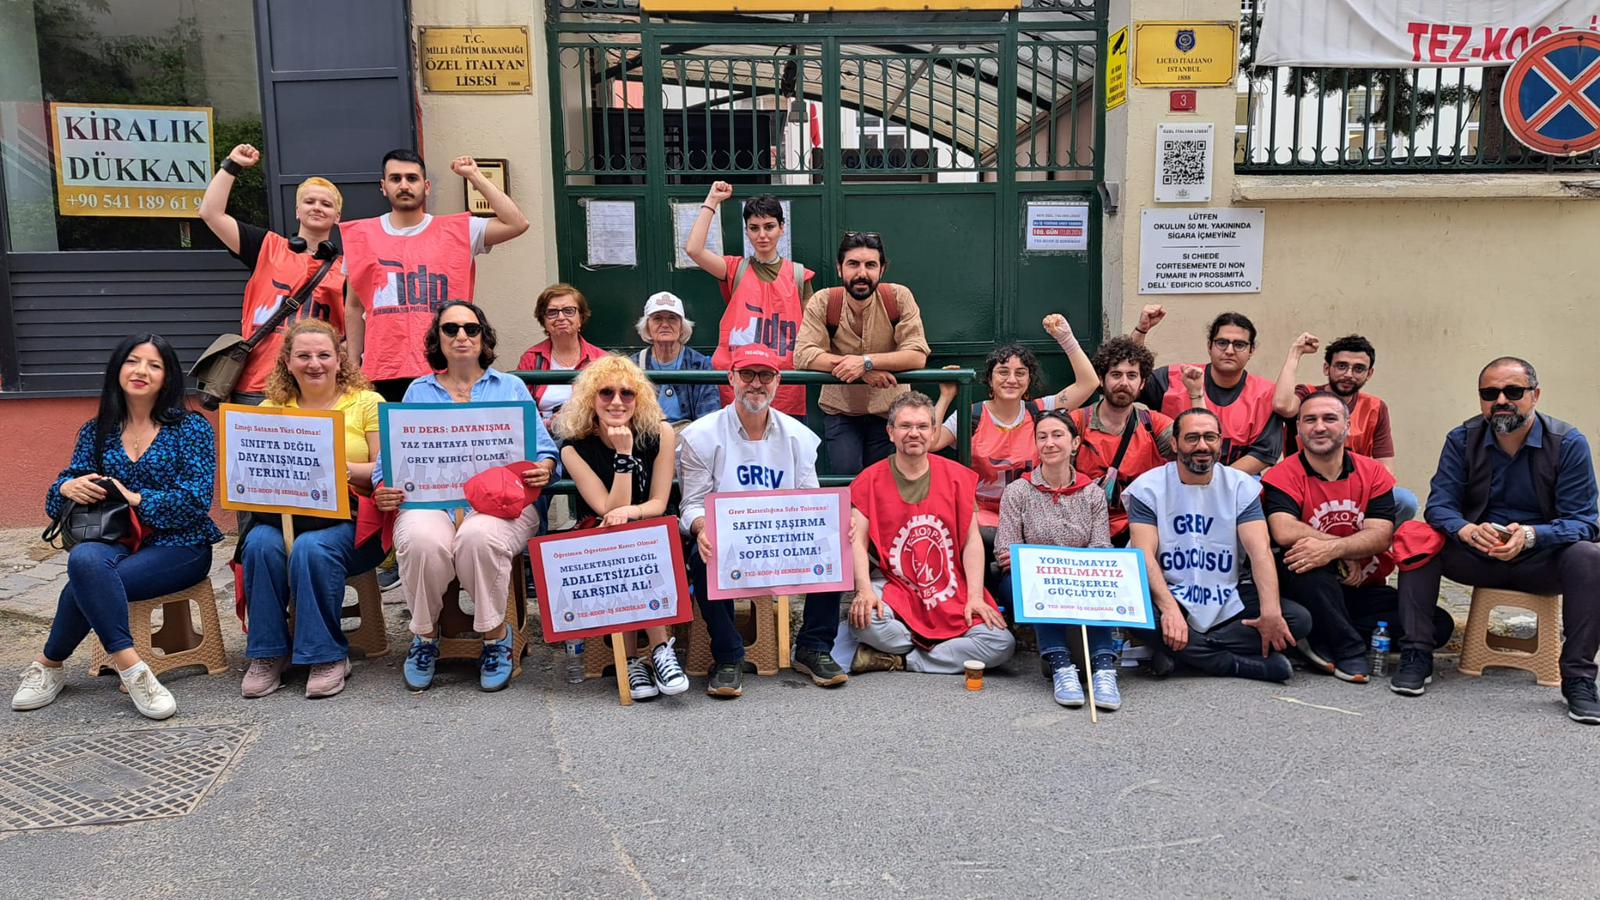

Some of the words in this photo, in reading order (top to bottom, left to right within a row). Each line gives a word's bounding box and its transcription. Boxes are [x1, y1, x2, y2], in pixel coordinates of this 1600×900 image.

[463, 34, 485, 43] T.C.
[426, 45, 448, 54] MİLLİ
[451, 45, 479, 54] EĞİTİM
[481, 45, 523, 54] BAKANLIĞI
[425, 57, 462, 71] ÖZEL
[466, 57, 525, 71] İTALYAN
[456, 73, 497, 86] LİSESİ
[1180, 95, 1187, 106] 3
[64, 111, 206, 144] KİRALIK
[66, 151, 206, 183] DÜKKAN
[66, 193, 98, 208] +90
[103, 194, 130, 209] 541
[138, 195, 165, 209] 189
[170, 196, 187, 210] 61
[1198, 231, 1236, 240] İÇMEYİNİZ
[1199, 270, 1244, 278] PROSSIMITÀ
[1204, 280, 1252, 288] SCOLASTICO
[403, 426, 416, 434] BU
[419, 425, 449, 434] DERS:
[451, 423, 511, 433] DAYANIŞMA
[240, 438, 280, 450] SINIFTA
[284, 440, 316, 452] DEĞİL
[401, 441, 420, 449] YAZ
[422, 440, 468, 449] TAHTAYA
[471, 437, 514, 447] UNUTMA
[238, 452, 320, 467] DAYANIŞMADA
[407, 456, 435, 464] GREV
[438, 454, 472, 464] KIRICI
[475, 453, 509, 462] OLMA!
[248, 466, 290, 479] YERİNİ
[293, 470, 310, 481] AL!
[737, 465, 784, 489] GREV
[732, 520, 772, 531] SAFINI
[775, 517, 826, 530] ŞAŞIRMA
[1173, 513, 1214, 535] GREV
[745, 532, 815, 545] YÖNETİMİN
[739, 548, 779, 560] SOPASI
[783, 546, 822, 557] OLMA!
[559, 557, 626, 574] MESLEKTAŞINI
[628, 552, 657, 564] DEĞİL
[1039, 556, 1118, 568] YORULMAYIZ
[562, 562, 659, 587] ADALETSİZLİĞİ
[1036, 565, 1124, 578] KIRILMAYIZ
[1043, 577, 1119, 588] BİRLEŞEREK
[572, 583, 628, 600] KARŞINA
[632, 580, 652, 591] AL!
[1048, 587, 1117, 598] GÜÇLÜYÜZ!
